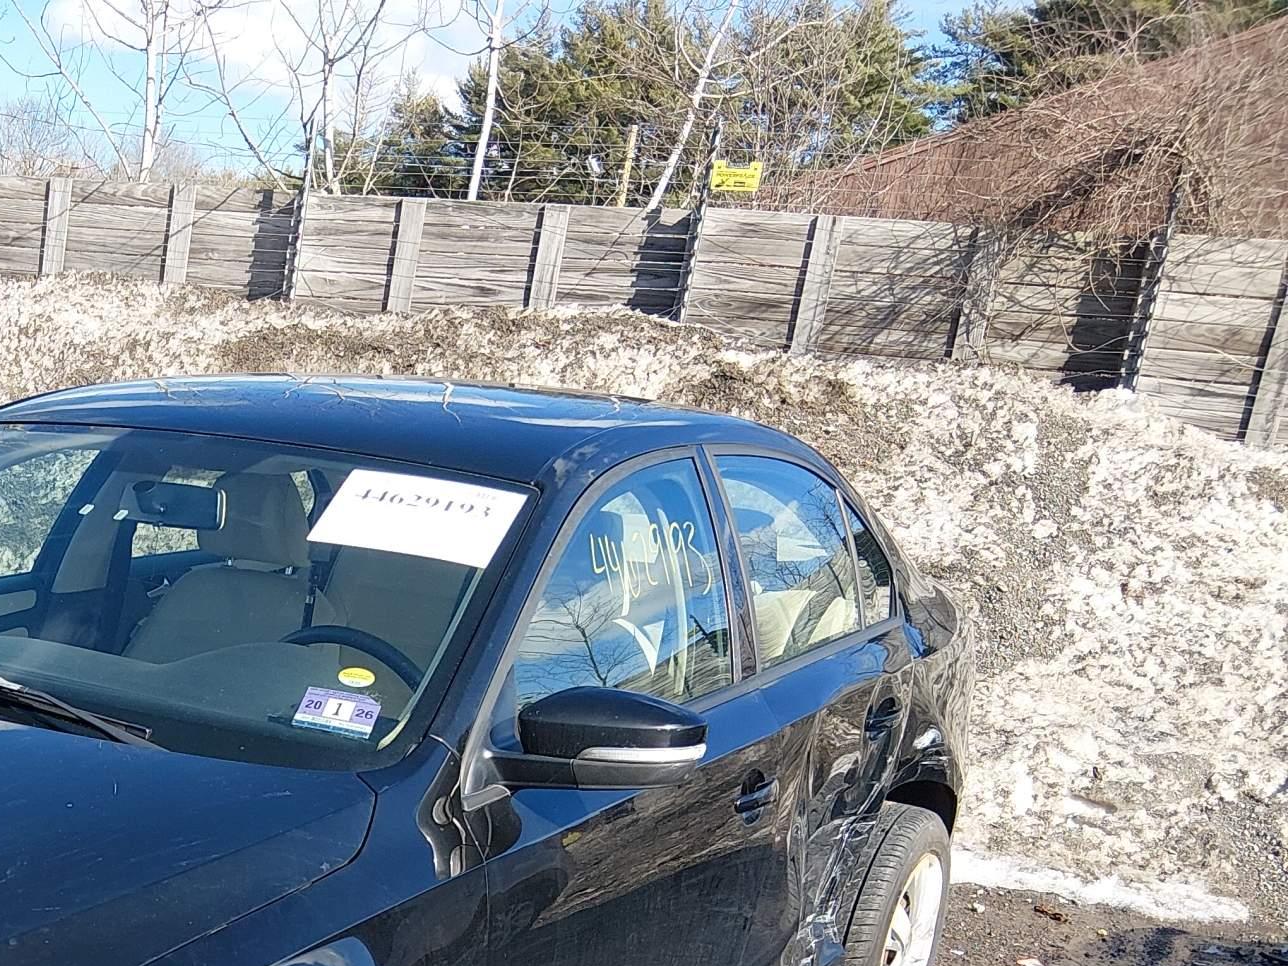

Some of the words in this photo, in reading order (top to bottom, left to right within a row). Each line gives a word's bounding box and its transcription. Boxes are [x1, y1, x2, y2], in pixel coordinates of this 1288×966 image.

[355, 488, 491, 517] 44629193
[304, 699, 323, 710] 20
[332, 702, 343, 716] 1
[355, 708, 374, 720] 26
